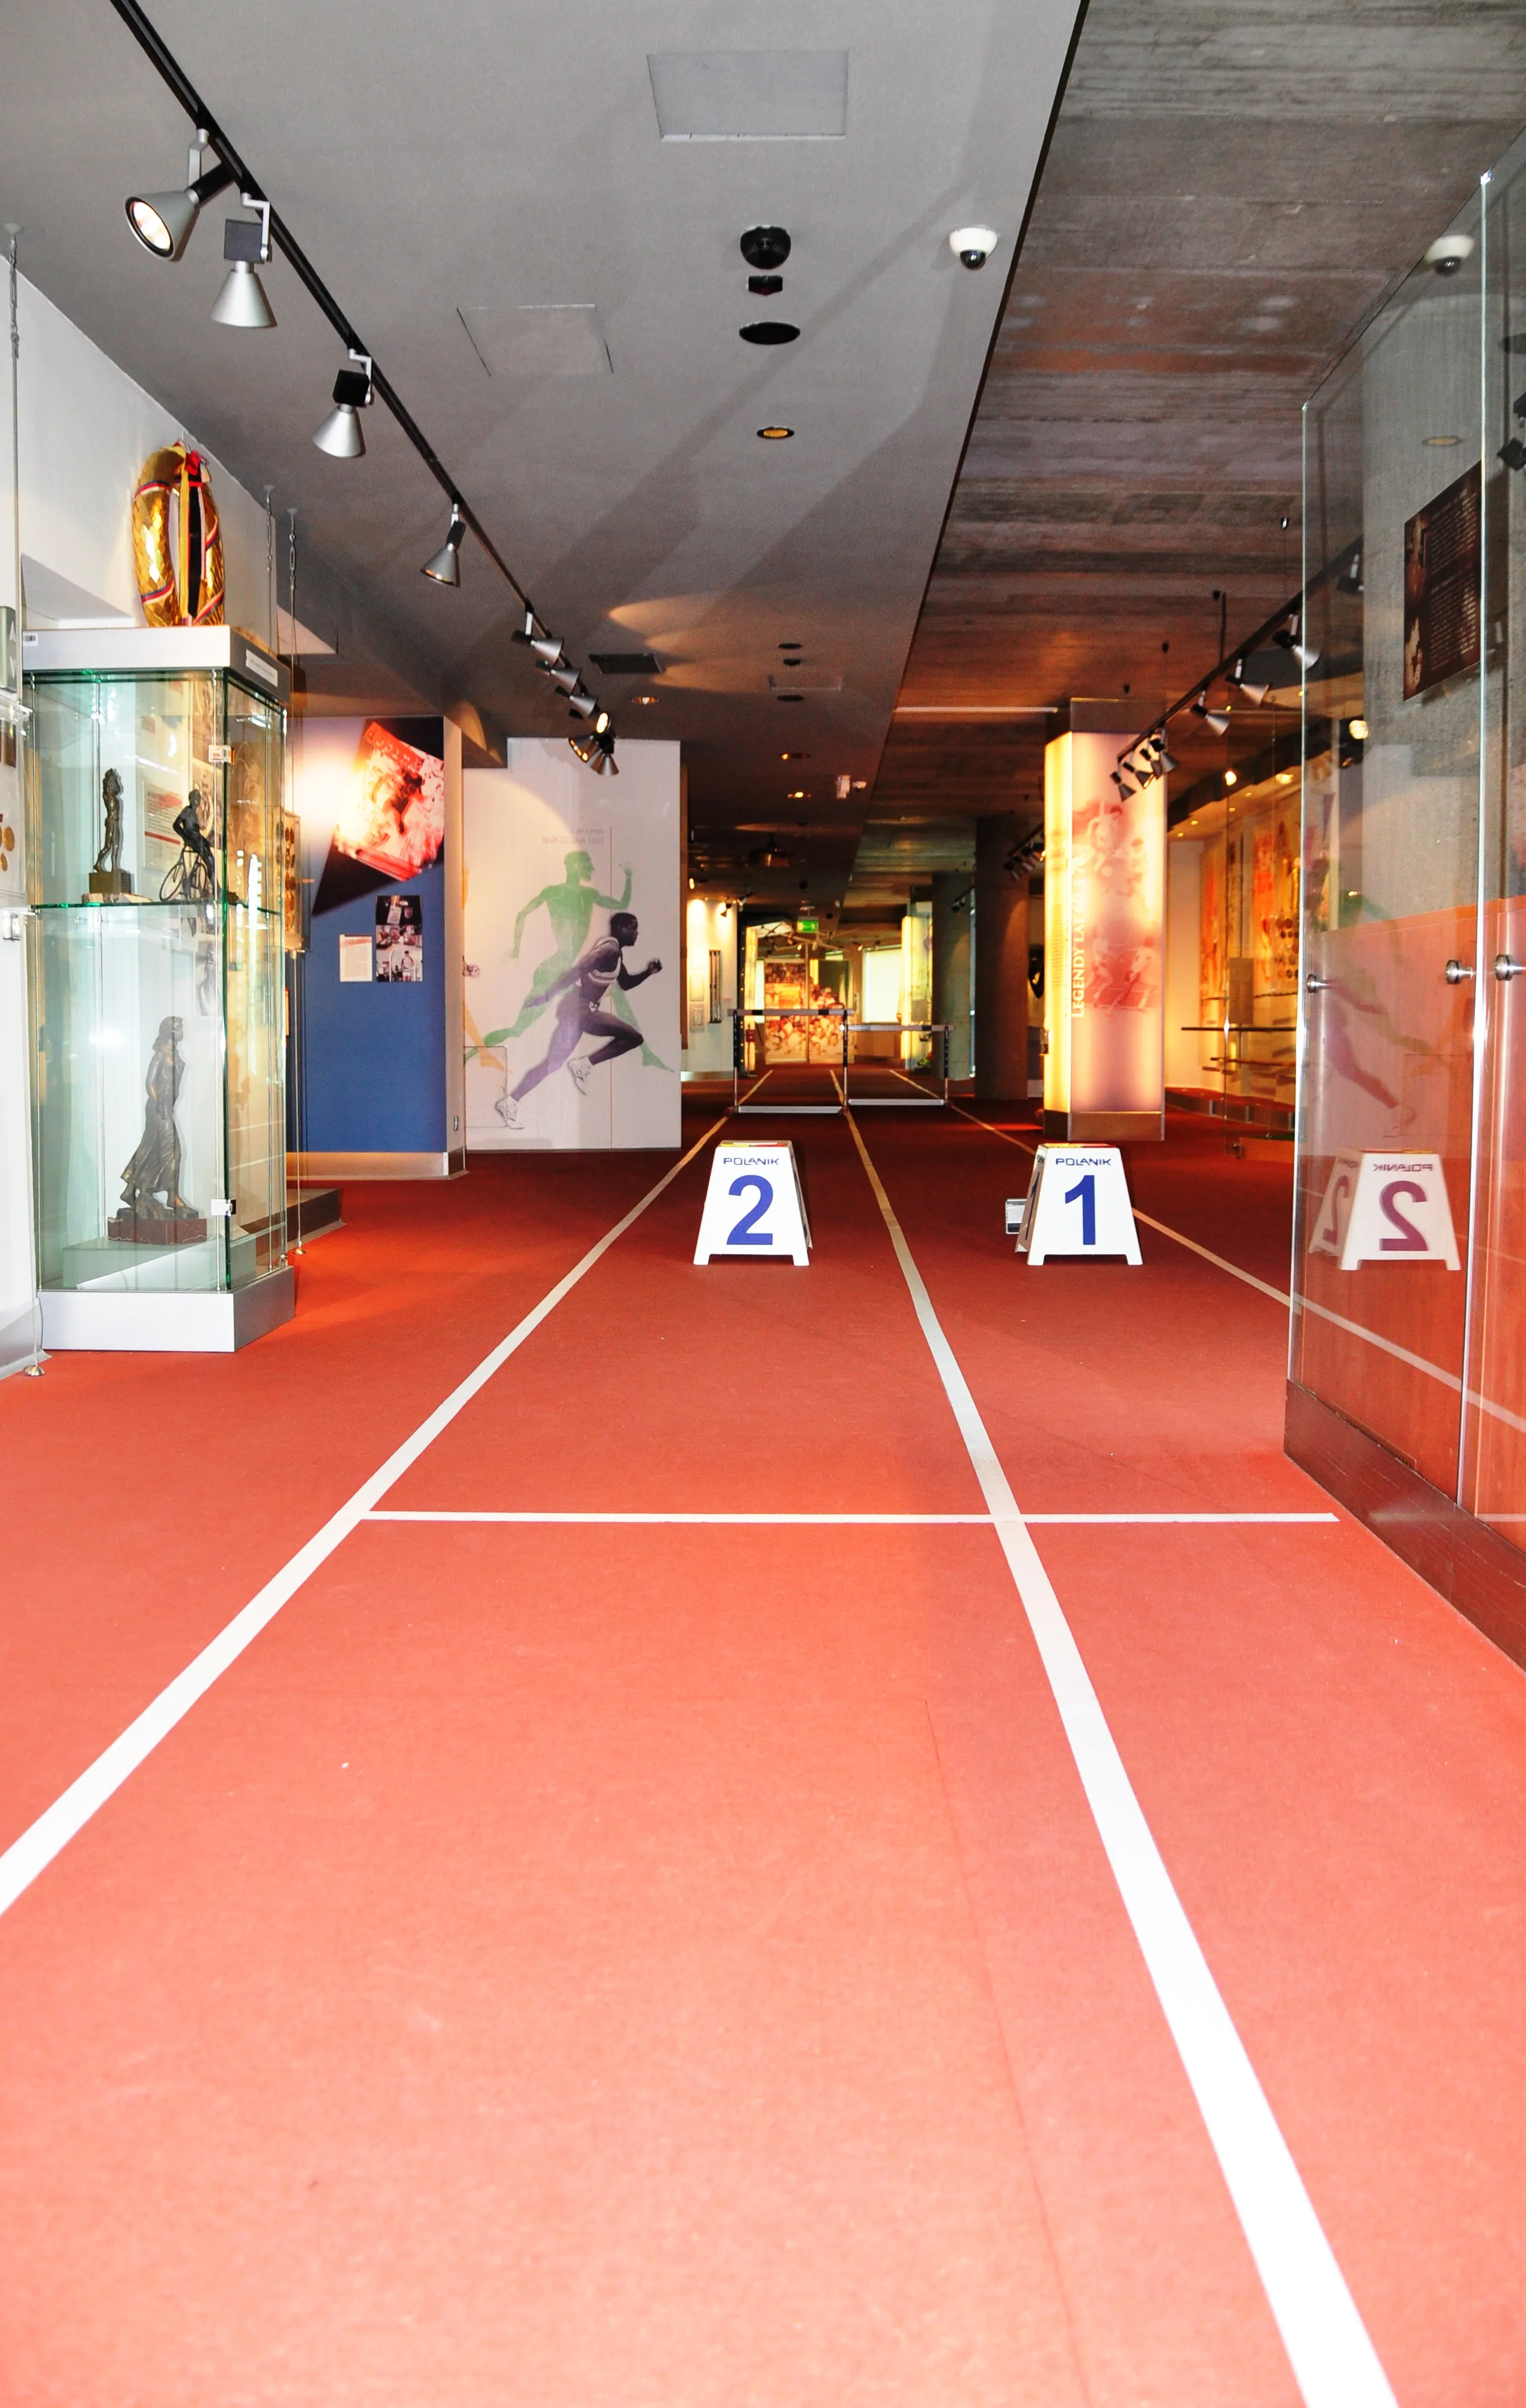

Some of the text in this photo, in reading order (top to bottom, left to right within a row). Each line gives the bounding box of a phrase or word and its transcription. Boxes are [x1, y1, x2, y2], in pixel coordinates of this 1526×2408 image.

[1073, 915, 1084, 942] LAT
[1071, 946, 1084, 1017] LEGENDY
[723, 1157, 779, 1166] POLANIK
[727, 1174, 774, 1245] 2
[1065, 1175, 1096, 1245] 1
